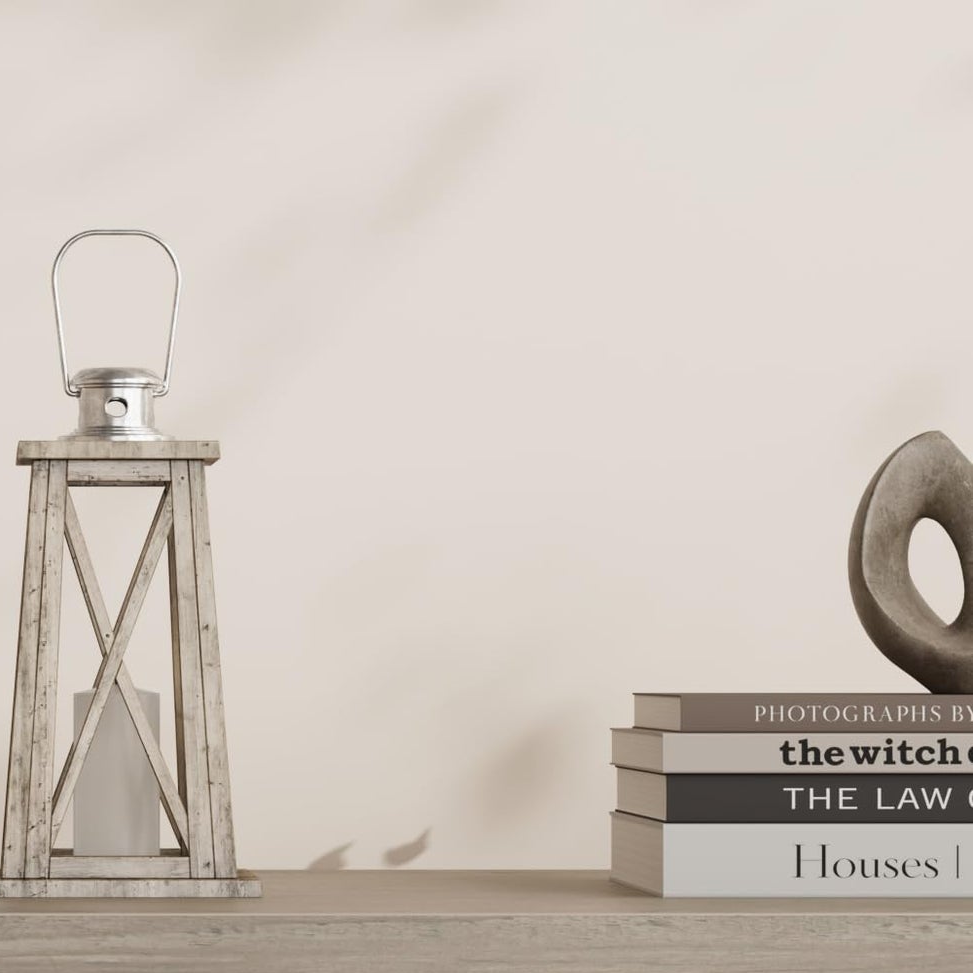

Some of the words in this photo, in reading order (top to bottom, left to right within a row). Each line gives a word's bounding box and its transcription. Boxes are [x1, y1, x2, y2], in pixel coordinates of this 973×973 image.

[754, 704, 942, 723] PHOTOGRAPHS
[779, 739, 845, 766] the
[849, 737, 963, 766] witch
[783, 787, 859, 811] THE
[876, 787, 953, 811] LAW
[792, 843, 939, 880] Houses
